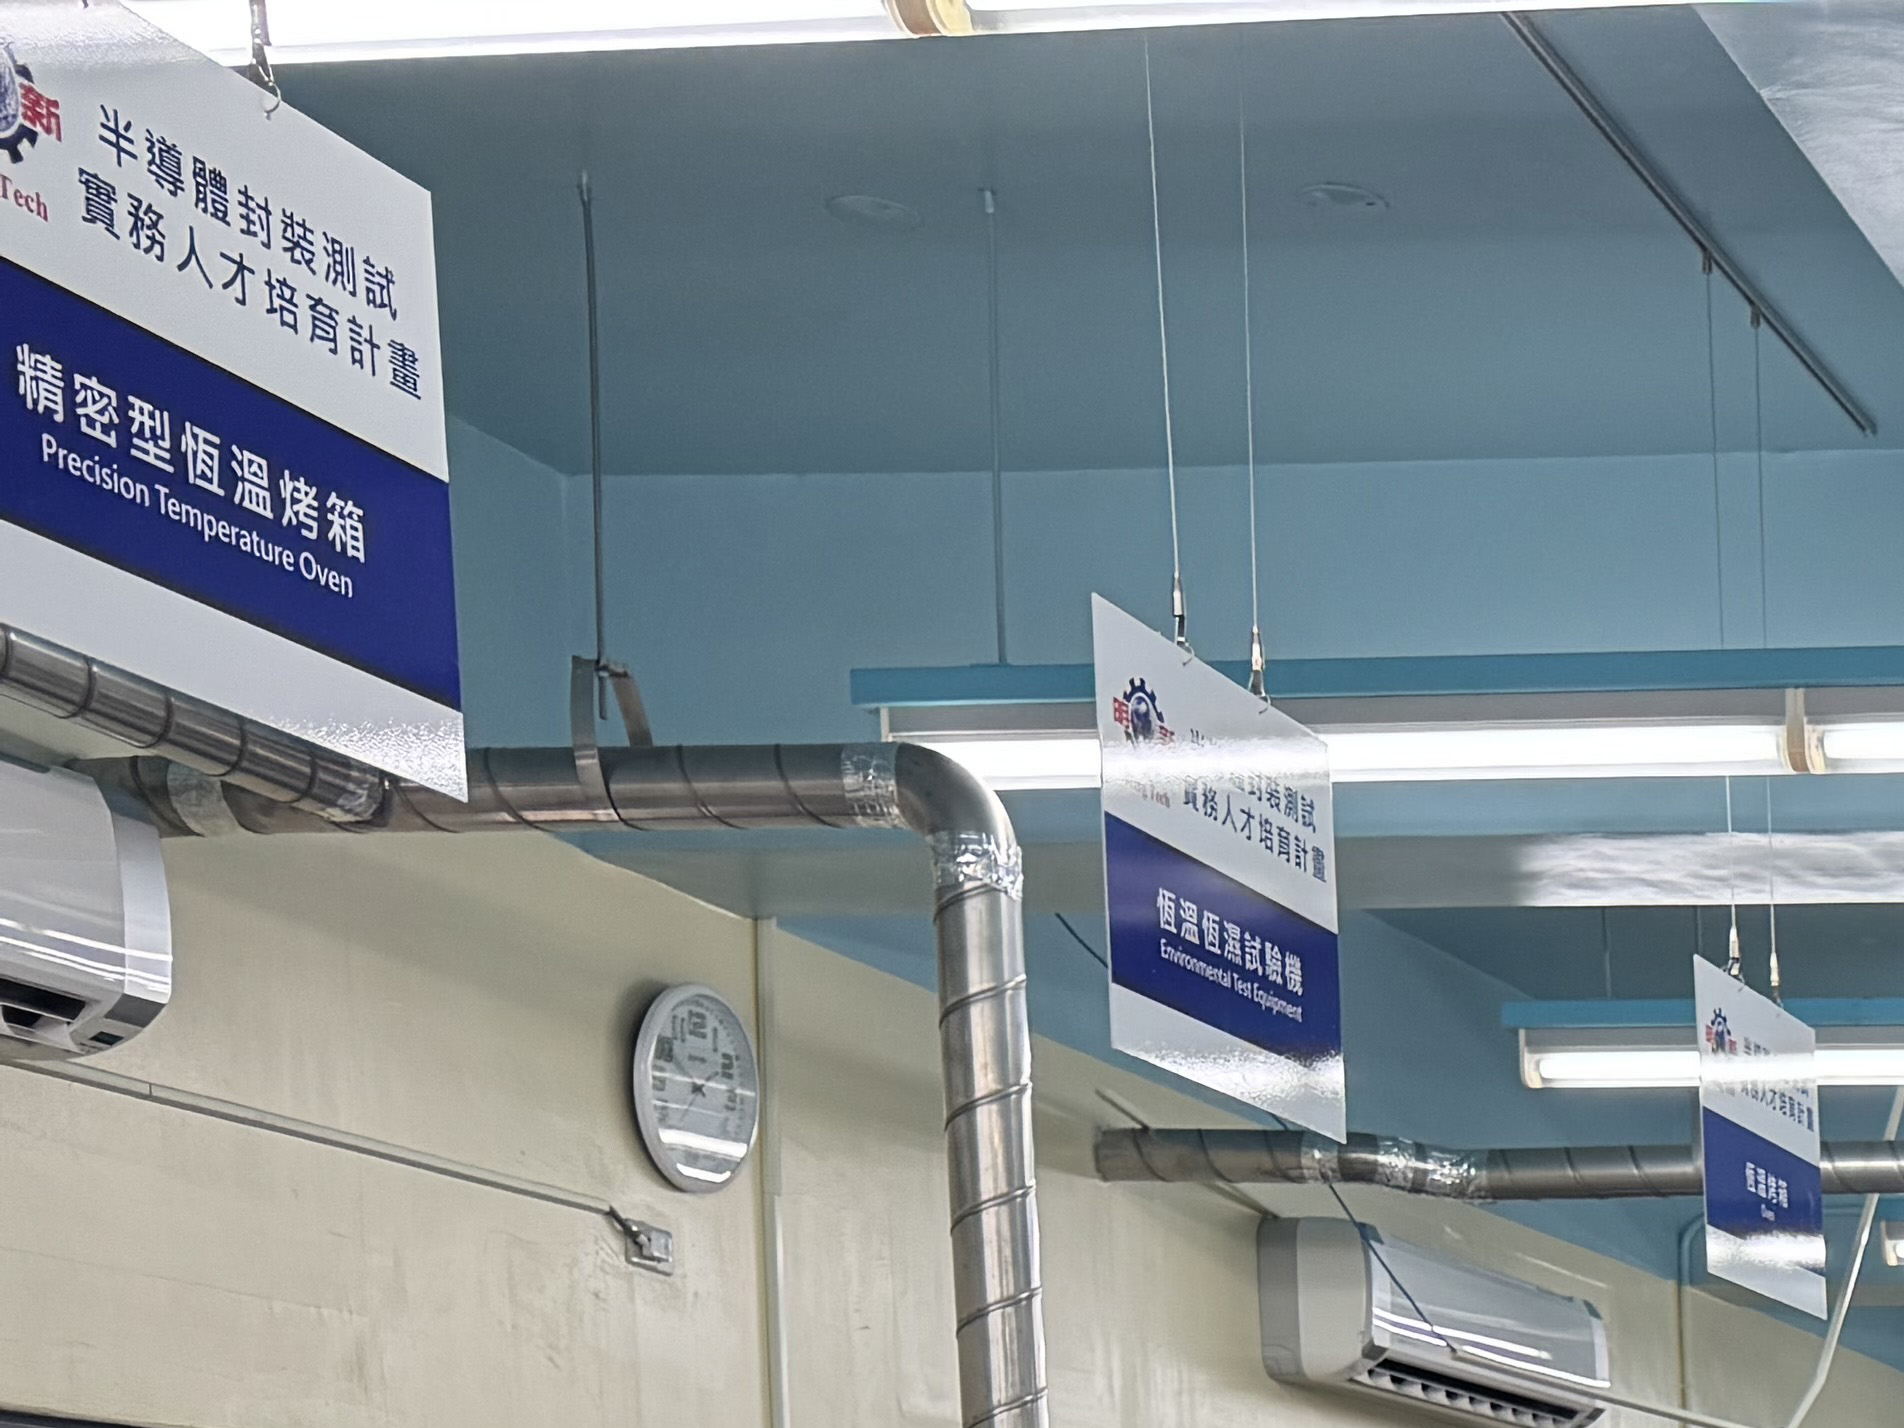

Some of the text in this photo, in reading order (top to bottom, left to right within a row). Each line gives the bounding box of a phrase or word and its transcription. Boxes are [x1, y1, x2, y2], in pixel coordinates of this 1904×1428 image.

[18, 81, 63, 143] 新
[77, 167, 422, 400] 實務人才培育計畫
[98, 104, 398, 322] 半導體封裝測試
[16, 342, 366, 564] 精密型恆溫烤箱
[41, 432, 354, 599] Precision Temperature Oven
[1156, 887, 1304, 997] 恆溫恆濕試驗機
[1232, 972, 1252, 1000] Test
